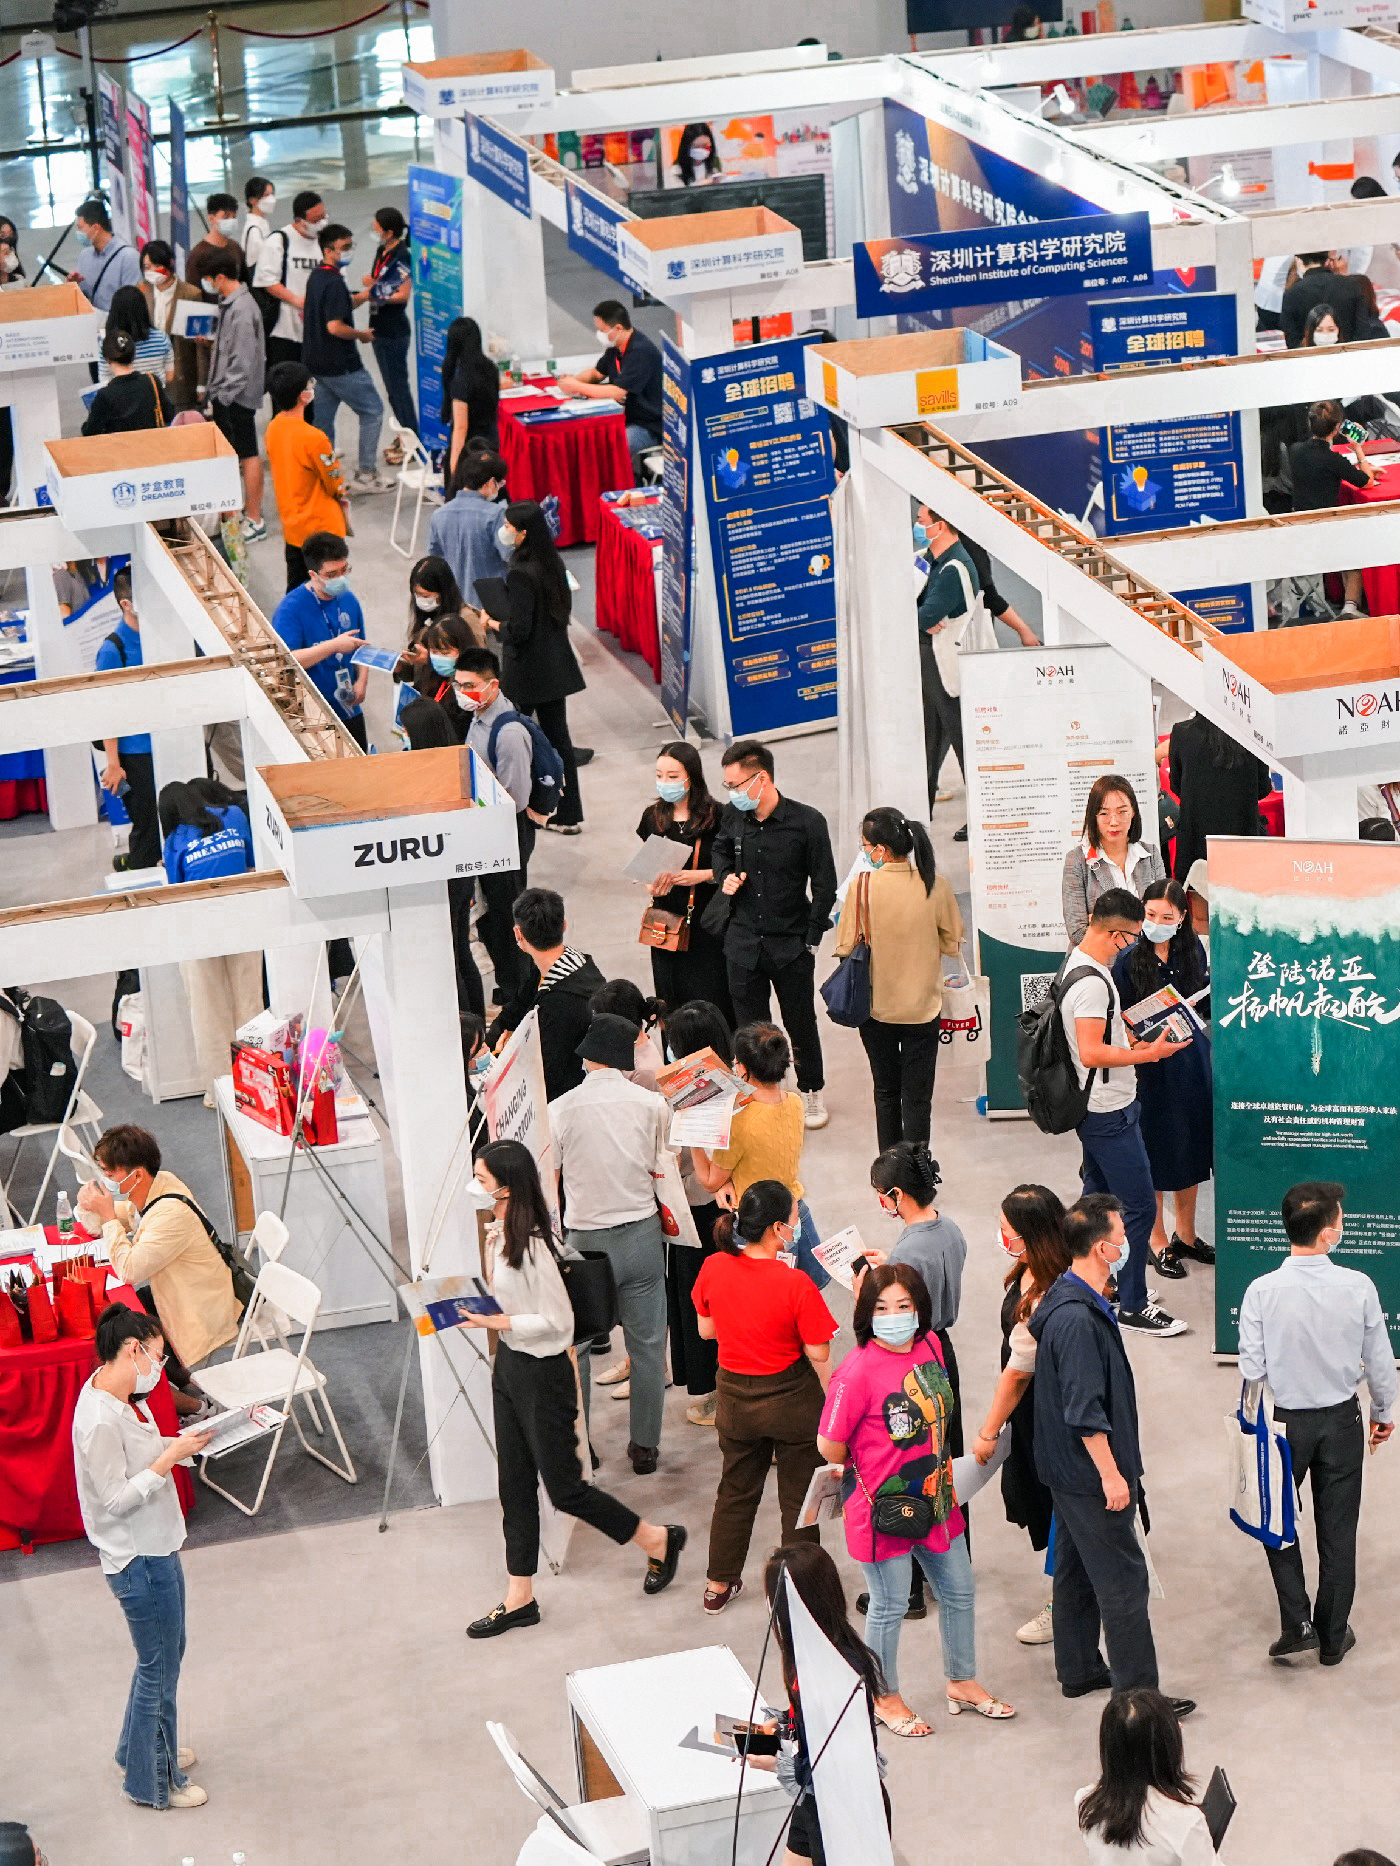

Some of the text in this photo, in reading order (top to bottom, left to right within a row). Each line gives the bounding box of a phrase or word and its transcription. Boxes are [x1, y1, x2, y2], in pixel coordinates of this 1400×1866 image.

[690, 247, 785, 269] 深圳计算科学研究院
[929, 230, 1127, 273] 深圳计算科学研究院
[930, 255, 1128, 287] Shenzhen Institute of Computing Sciences
[1119, 312, 1188, 326] 深圳计算科学研究院
[1127, 330, 1205, 354] 全球招聘
[724, 372, 795, 403] 全球招聘
[919, 390, 957, 407] savills
[141, 477, 185, 494] 梦盒教育
[141, 489, 186, 502] DREAMBOX
[1036, 665, 1074, 678] NOAH
[1222, 667, 1251, 709] NOAH
[265, 804, 285, 851] ZURU
[1293, 860, 1334, 874] NOAH
[1247, 950, 1377, 987] 登陆诺亚
[947, 1021, 970, 1029] FLYER
[495, 1084, 527, 1141] CHANGING
